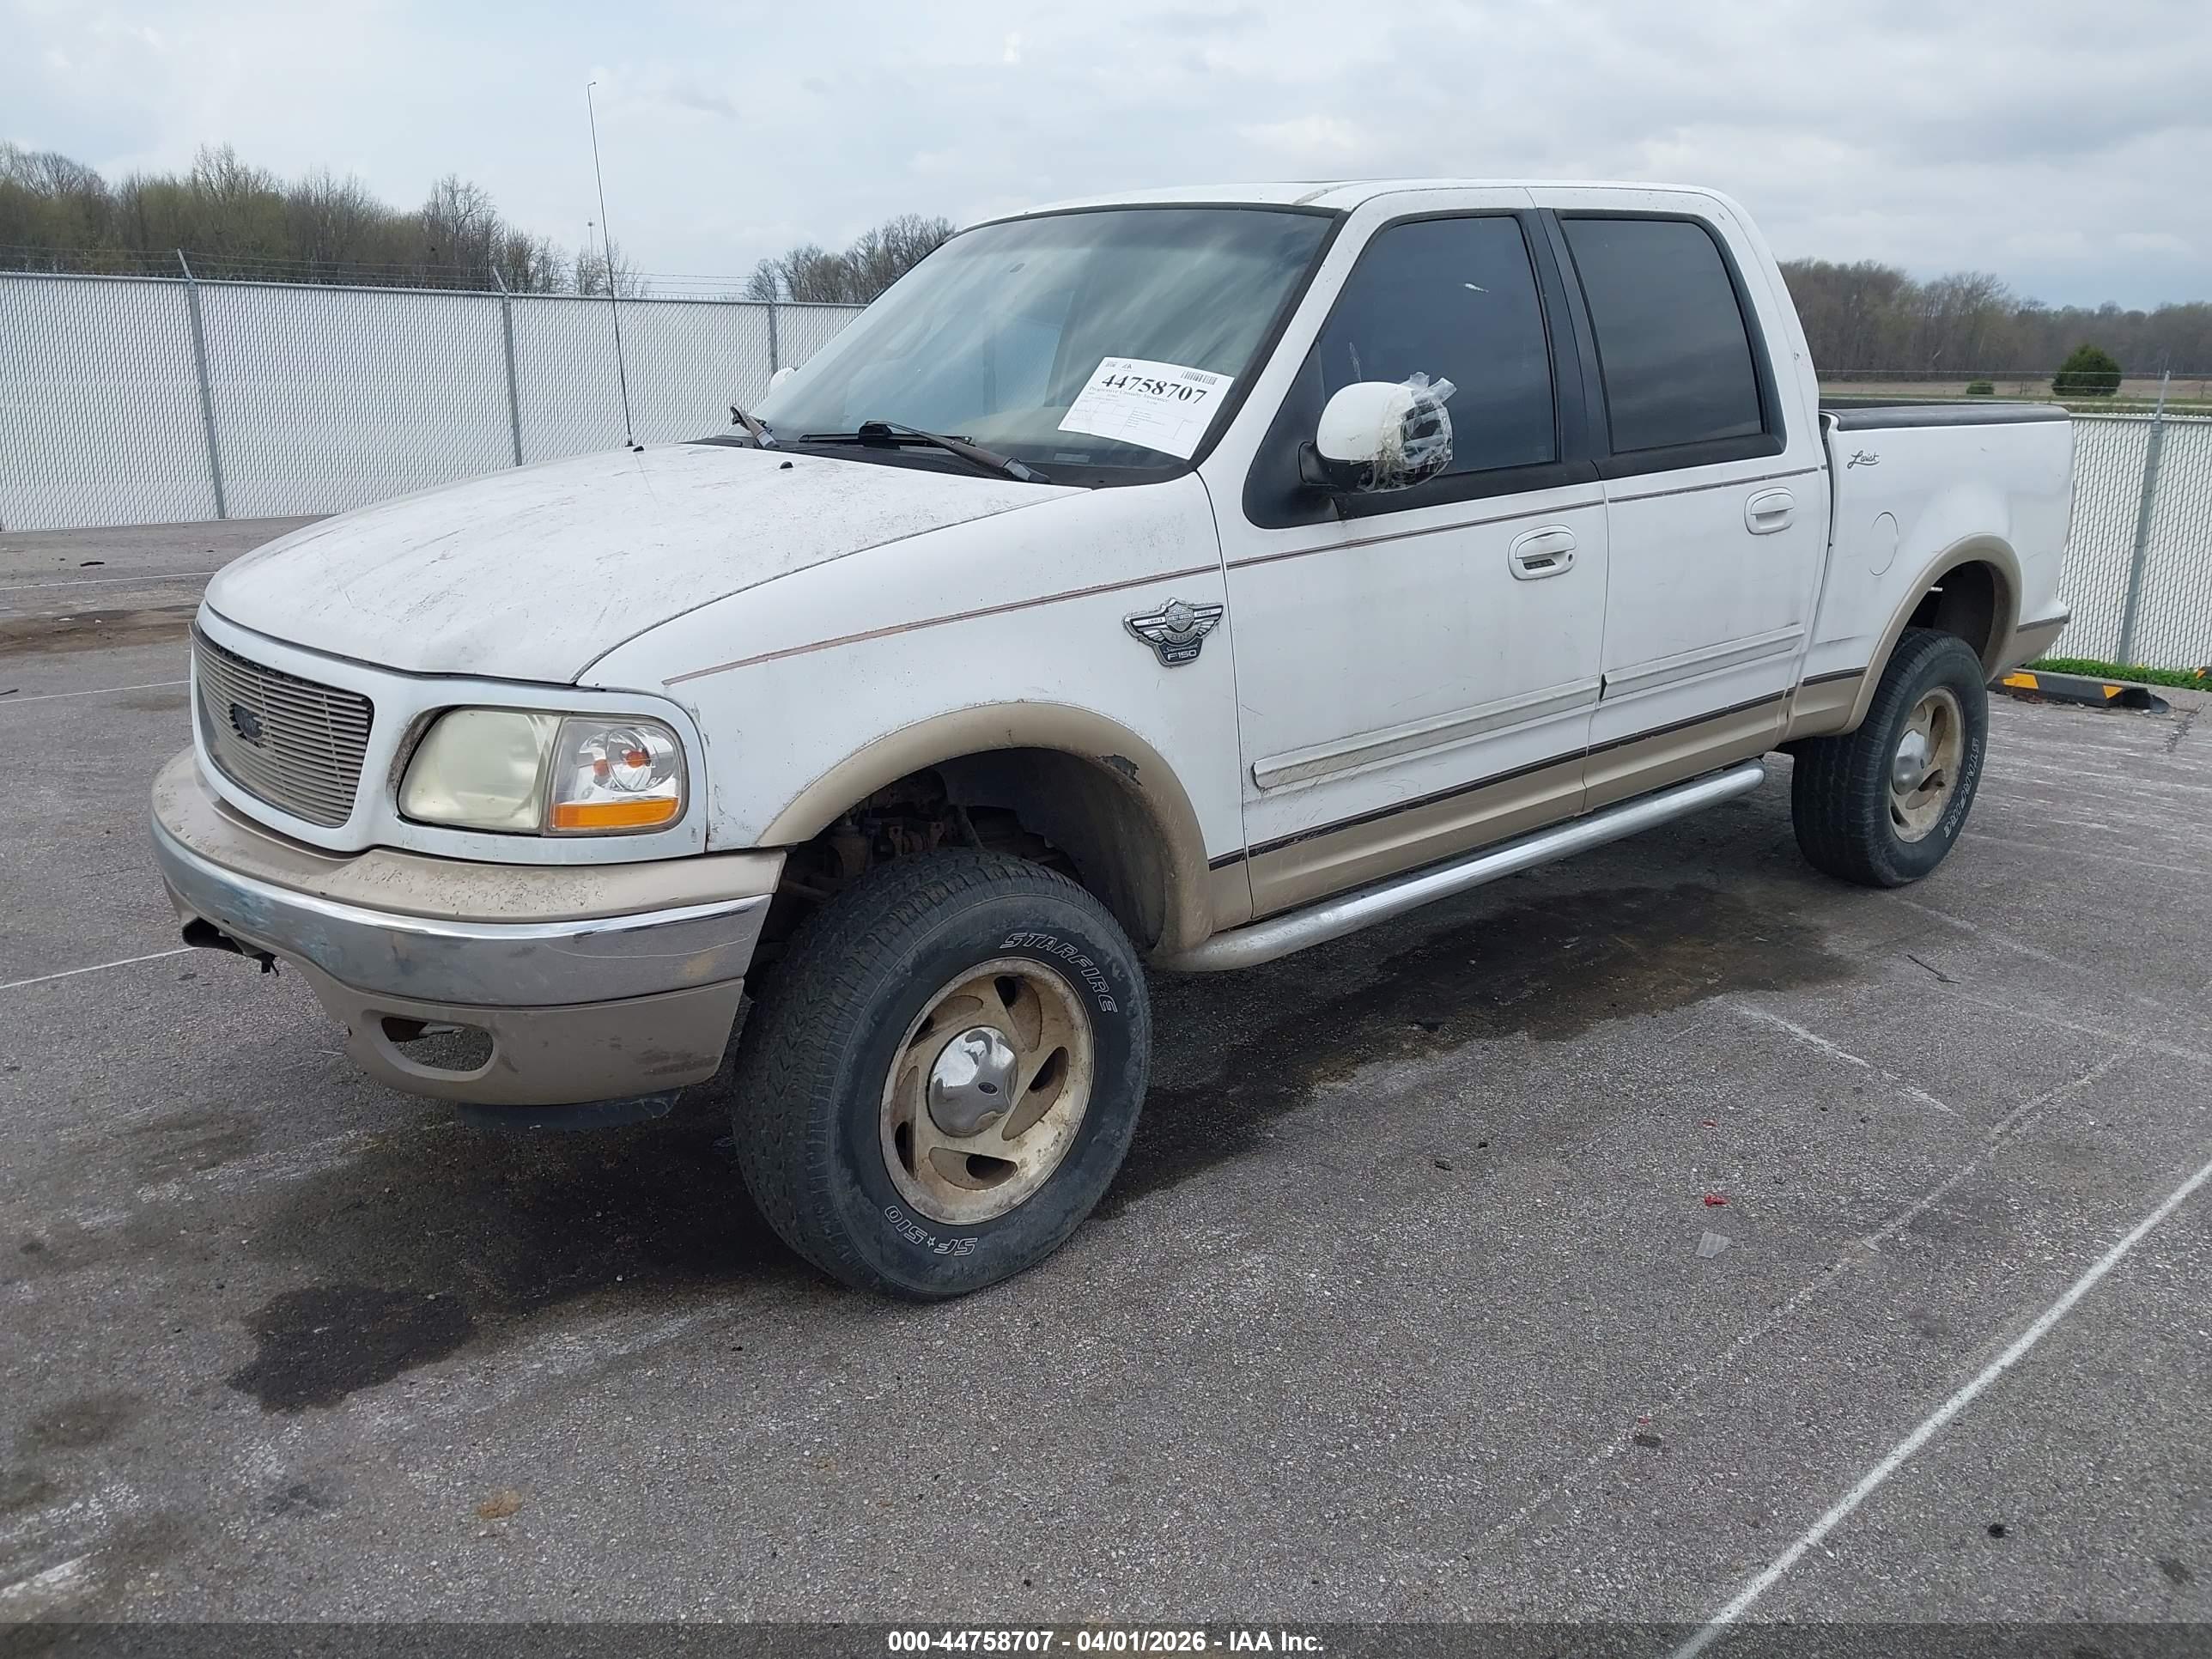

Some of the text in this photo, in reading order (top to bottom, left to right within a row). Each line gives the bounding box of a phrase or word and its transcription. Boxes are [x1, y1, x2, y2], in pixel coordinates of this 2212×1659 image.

[1101, 374, 1208, 404] 44758707
[1943, 738, 1979, 838] STARFIRE
[999, 932, 1118, 1013] STARFIRE
